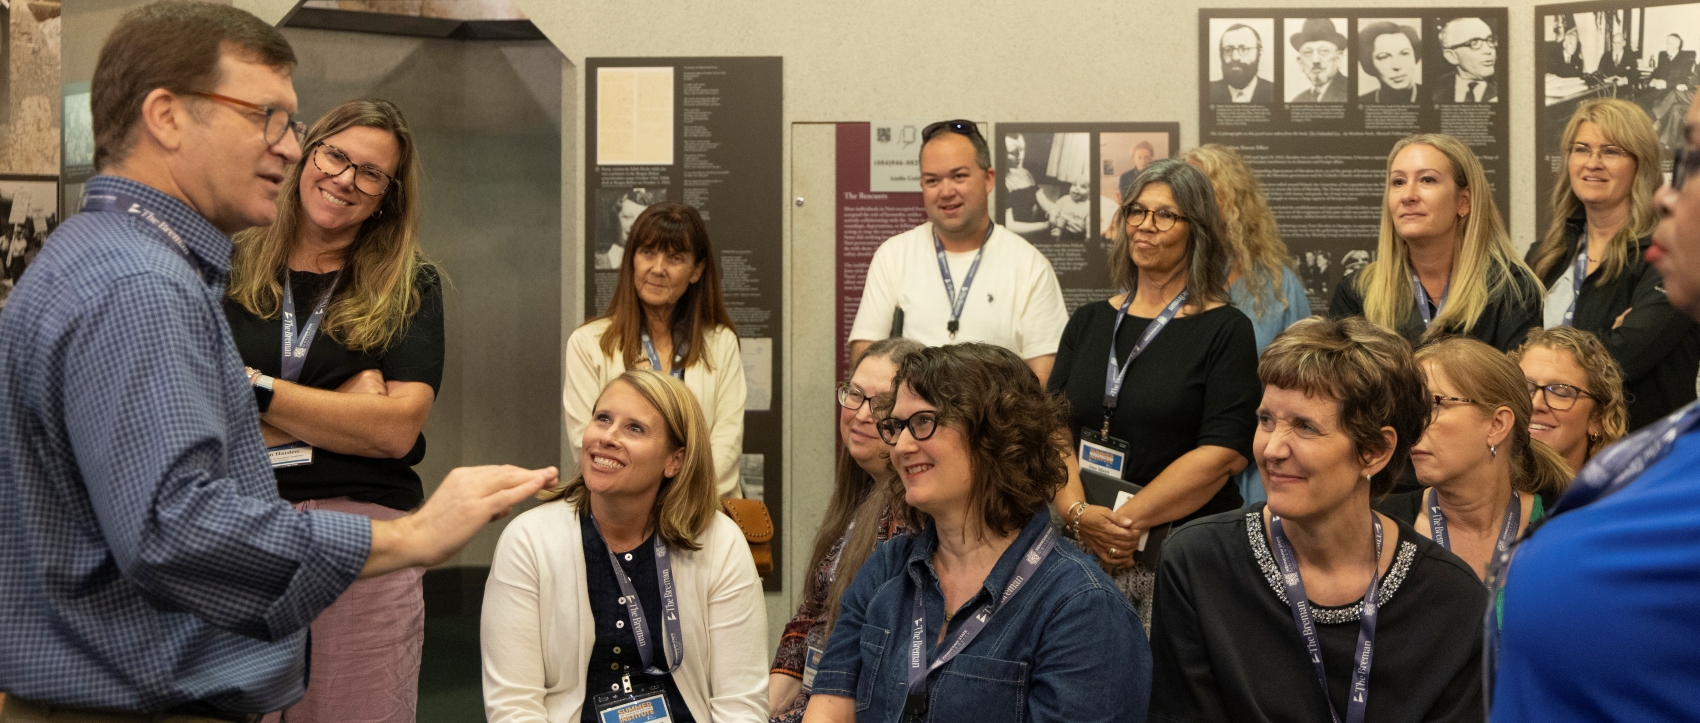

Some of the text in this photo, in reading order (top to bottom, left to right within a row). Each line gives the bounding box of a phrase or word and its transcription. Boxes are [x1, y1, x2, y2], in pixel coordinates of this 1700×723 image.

[284, 320, 294, 357] The Breman
[1432, 512, 1442, 527] The
[662, 569, 675, 613] The Breman
[629, 601, 647, 647] The Breman
[1296, 601, 1318, 654] The Breman
[911, 625, 924, 668] The Breman
[1354, 640, 1372, 692] The Breman
[617, 701, 653, 715] SUMMER
[620, 709, 655, 723] INSTITUTE
